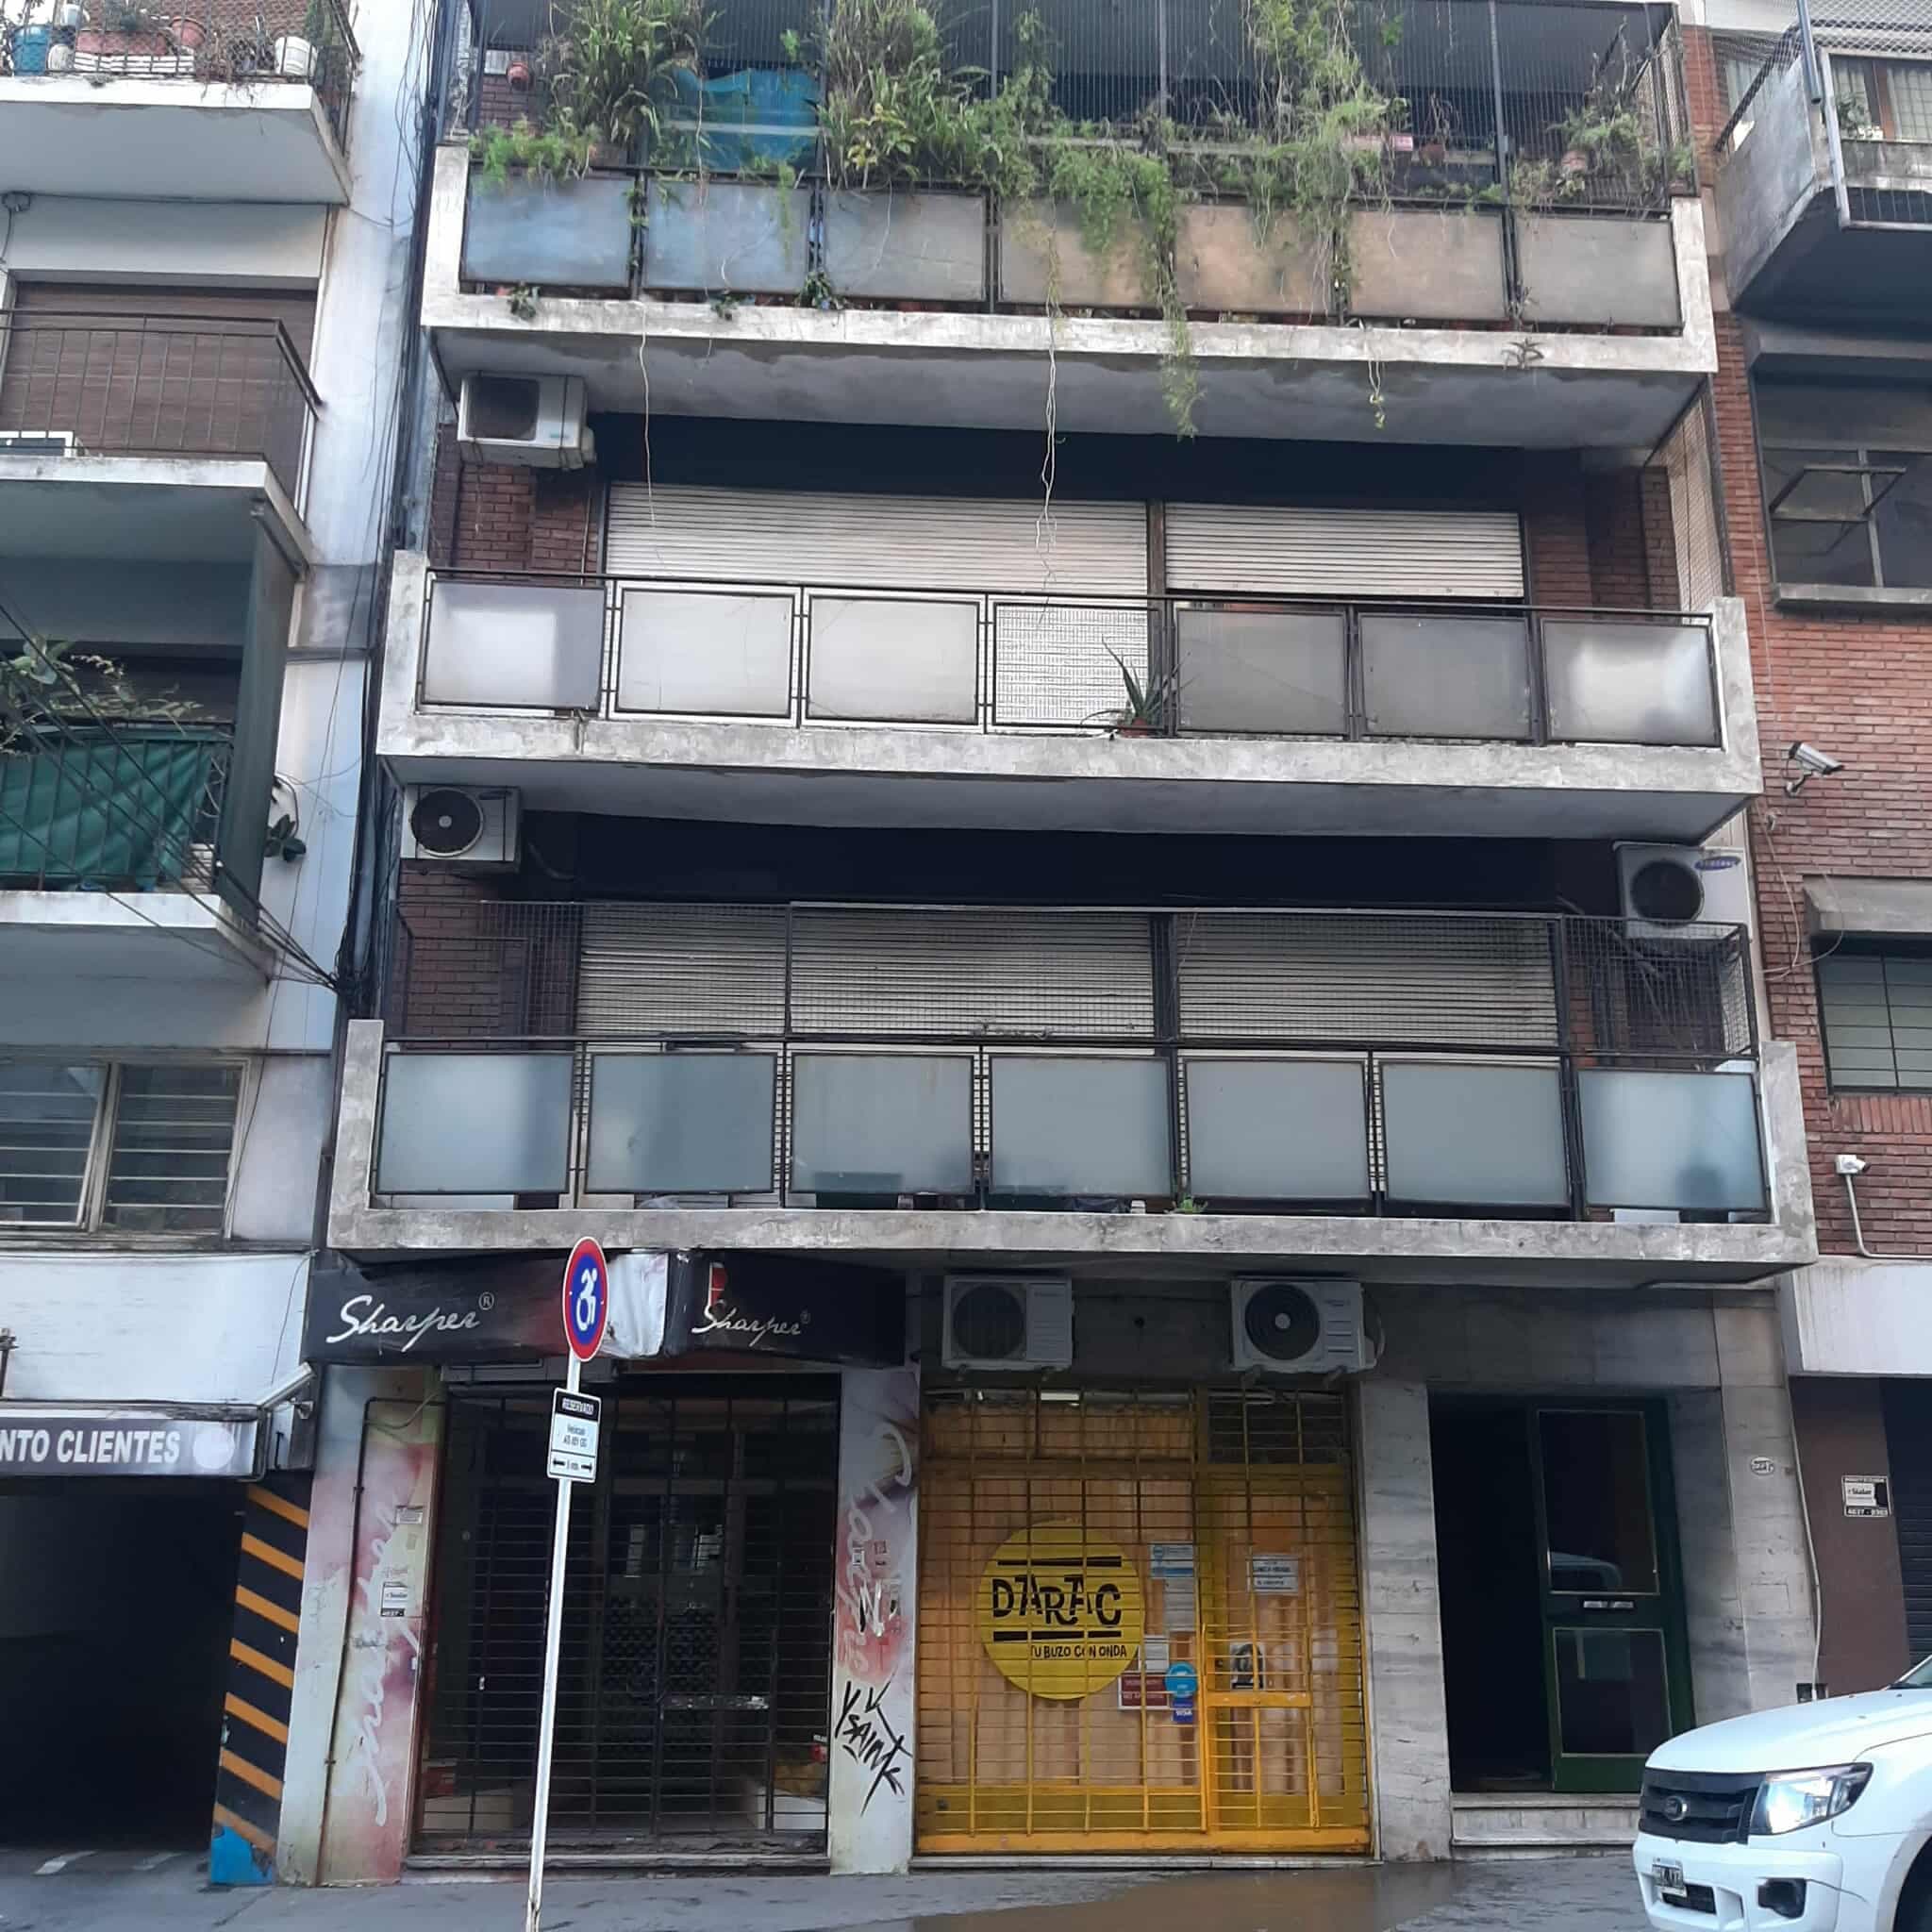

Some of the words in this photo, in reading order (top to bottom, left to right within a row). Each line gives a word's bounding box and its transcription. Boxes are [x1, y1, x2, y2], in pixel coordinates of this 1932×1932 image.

[325, 1294, 480, 1353] Sharper
[691, 1300, 801, 1347] Sharper
[57, 1430, 181, 1462] CLIENTES
[992, 1574, 1122, 1626] DARAC
[1043, 1645, 1072, 1658] BUZO
[1098, 1645, 1127, 1657] ONDA
